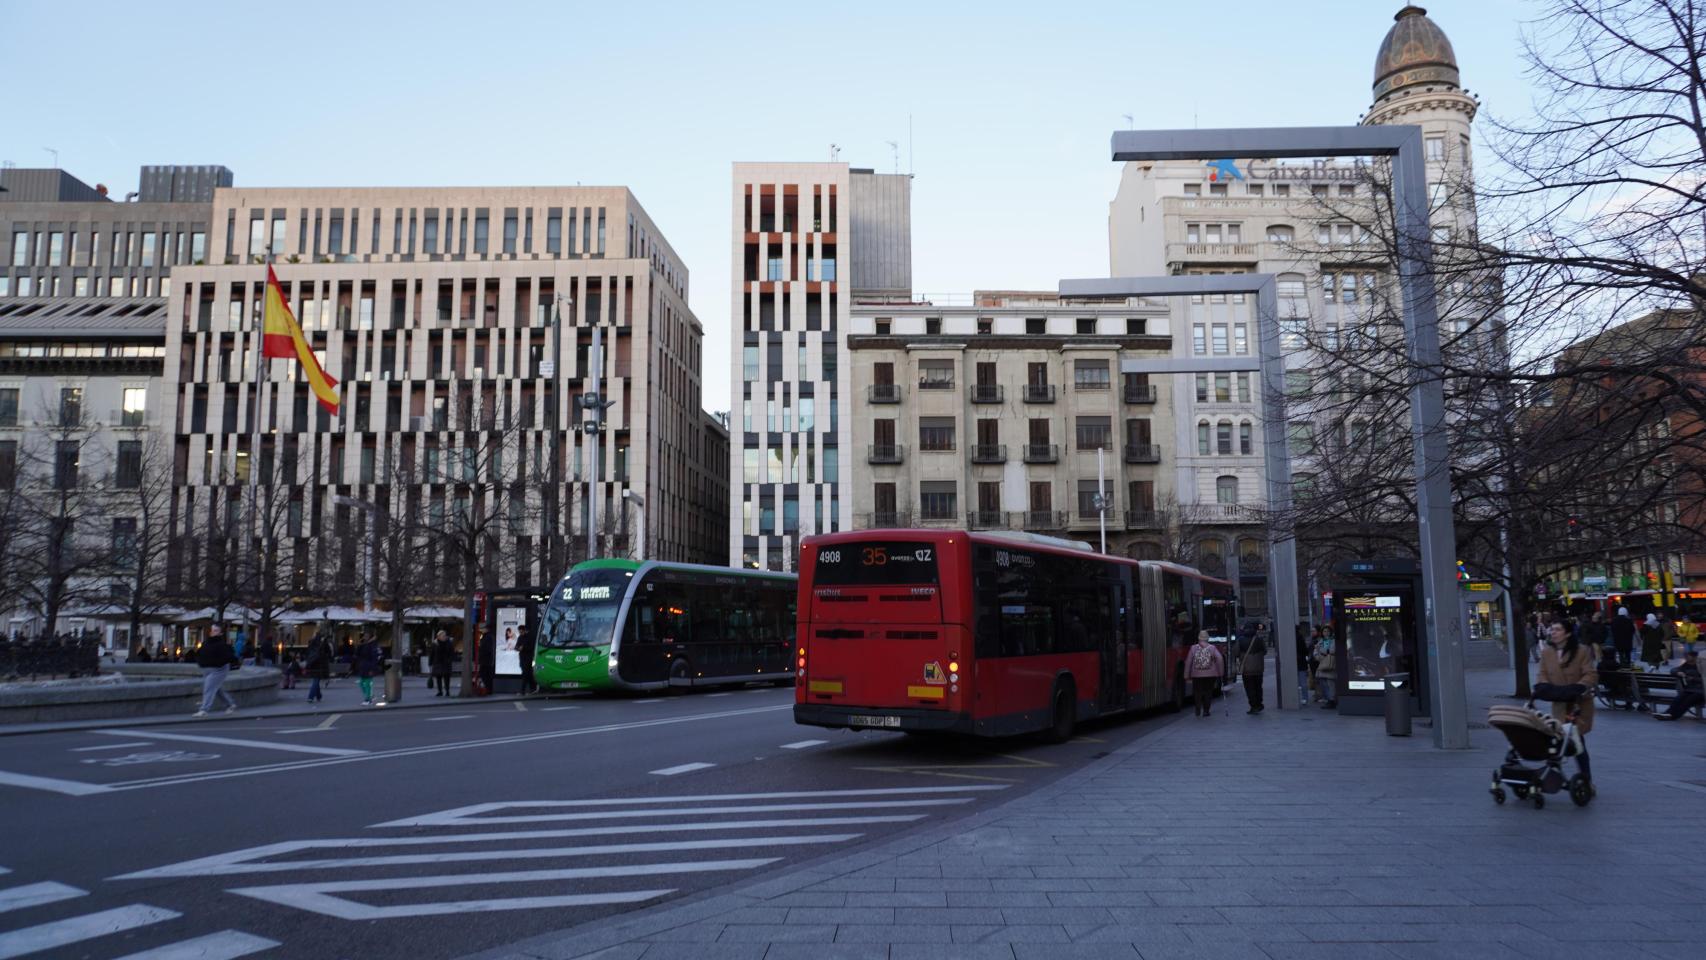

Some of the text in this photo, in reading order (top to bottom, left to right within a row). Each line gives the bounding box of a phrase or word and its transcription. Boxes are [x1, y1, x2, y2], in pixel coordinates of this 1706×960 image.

[1247, 159, 1366, 181] CaixaBank
[819, 551, 840, 563] 4908
[863, 547, 887, 565] 35
[563, 588, 573, 600] 22
